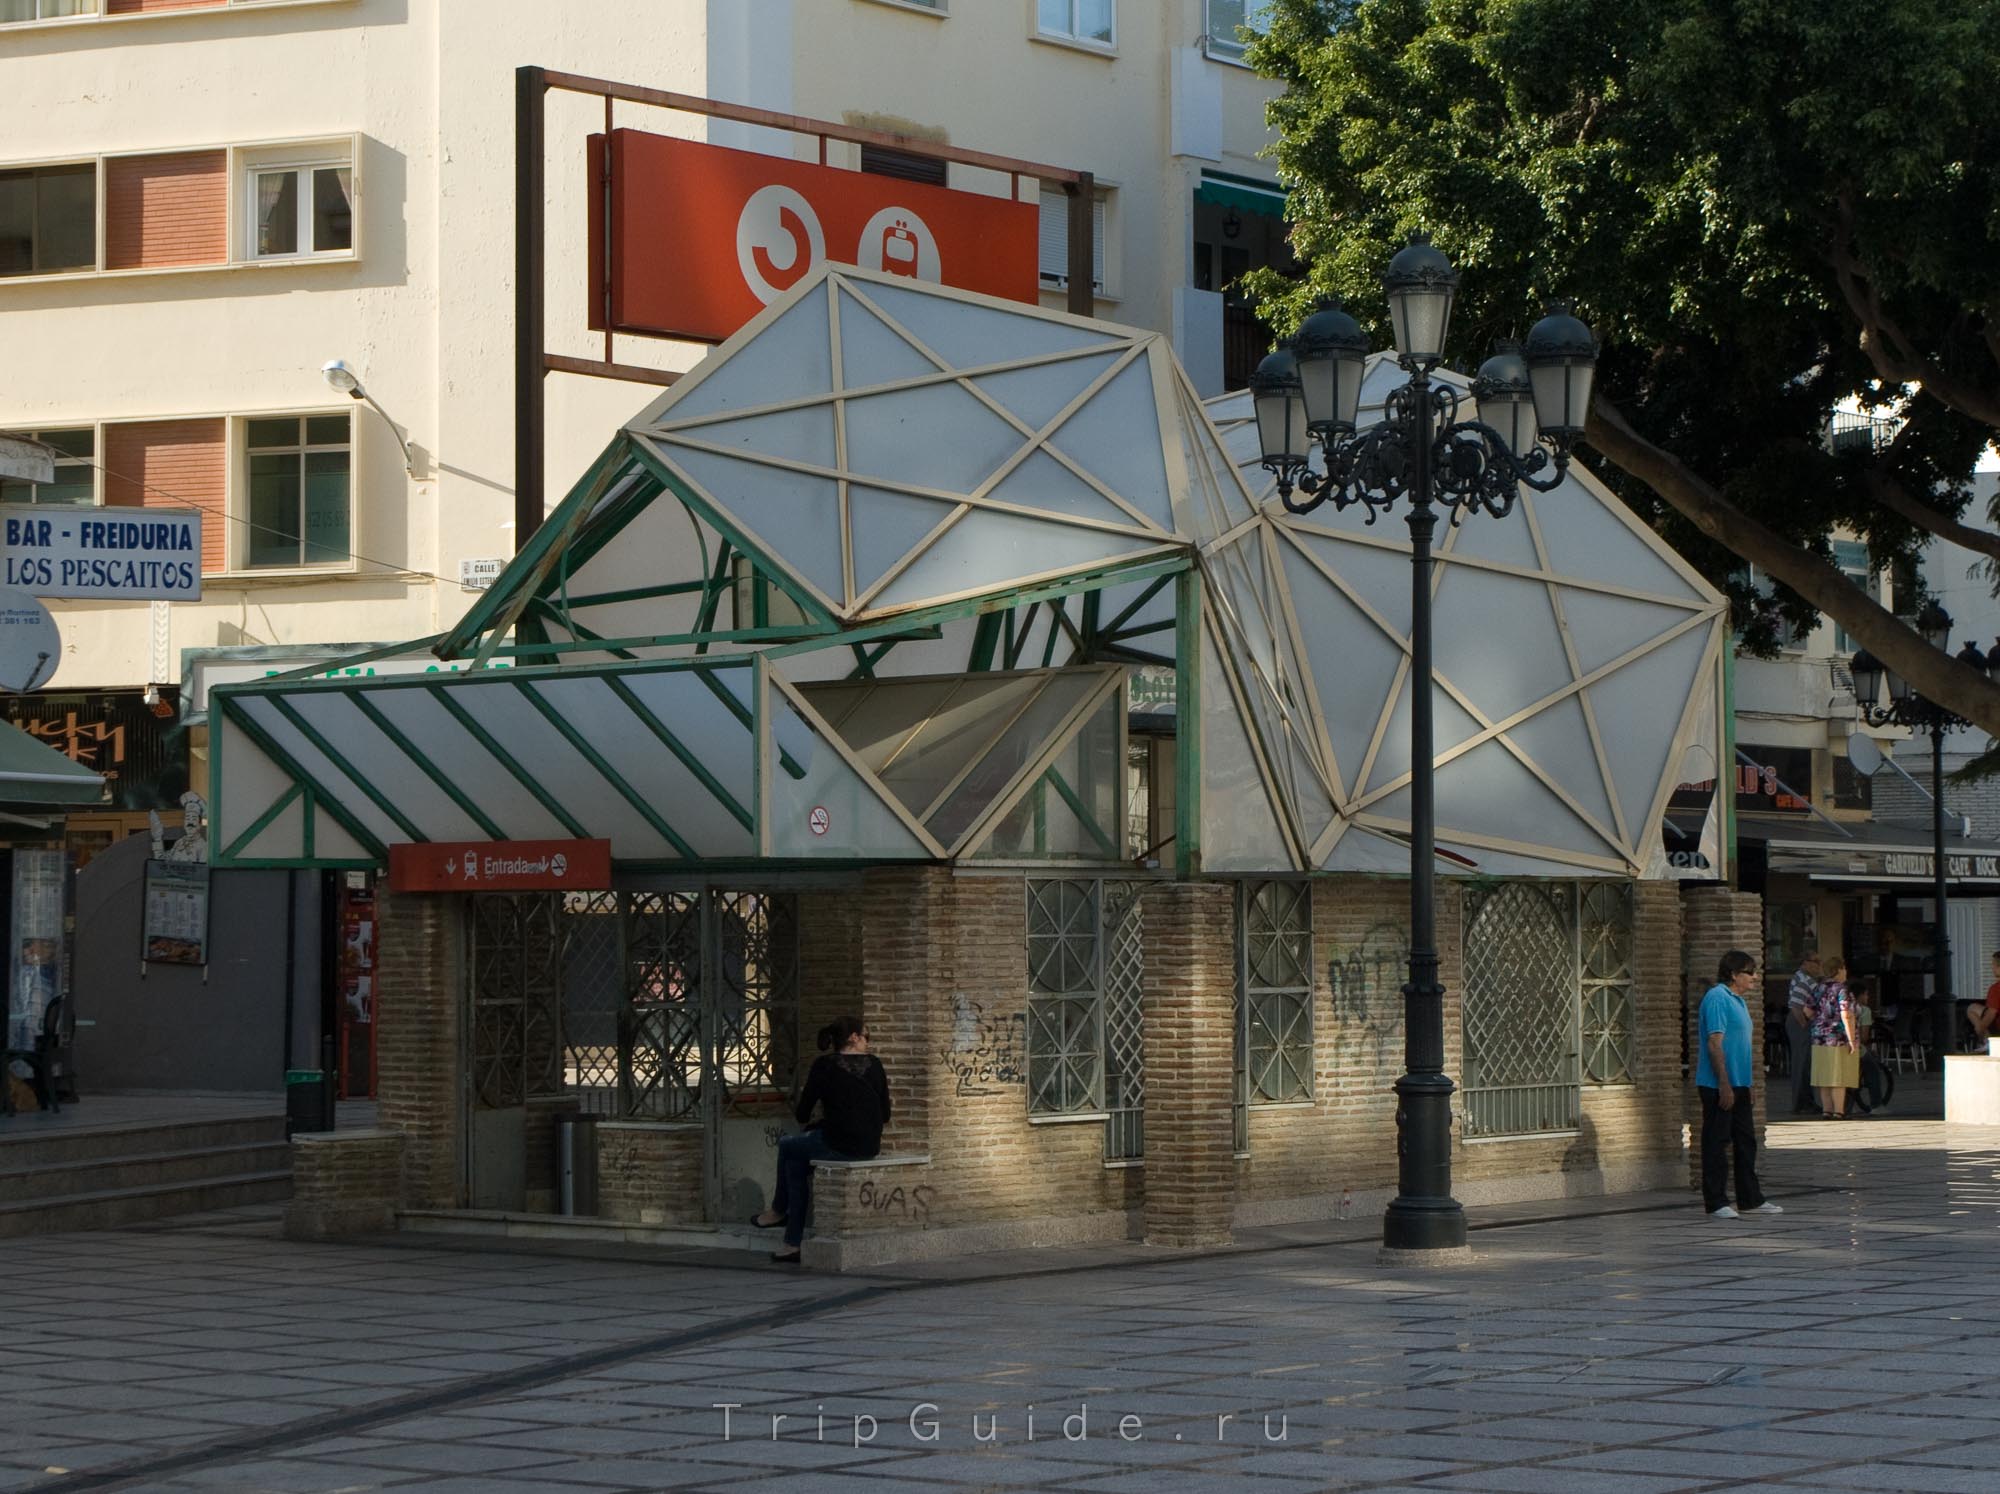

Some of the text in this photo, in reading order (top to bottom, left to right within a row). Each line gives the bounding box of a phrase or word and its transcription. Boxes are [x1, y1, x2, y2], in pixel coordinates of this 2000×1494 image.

[6, 518, 52, 547] BAR
[80, 521, 193, 550] FREIDURIA
[6, 557, 194, 589] LOS PESCAITOS
[474, 564, 496, 573] CALLE
[484, 855, 528, 875] Entrada
